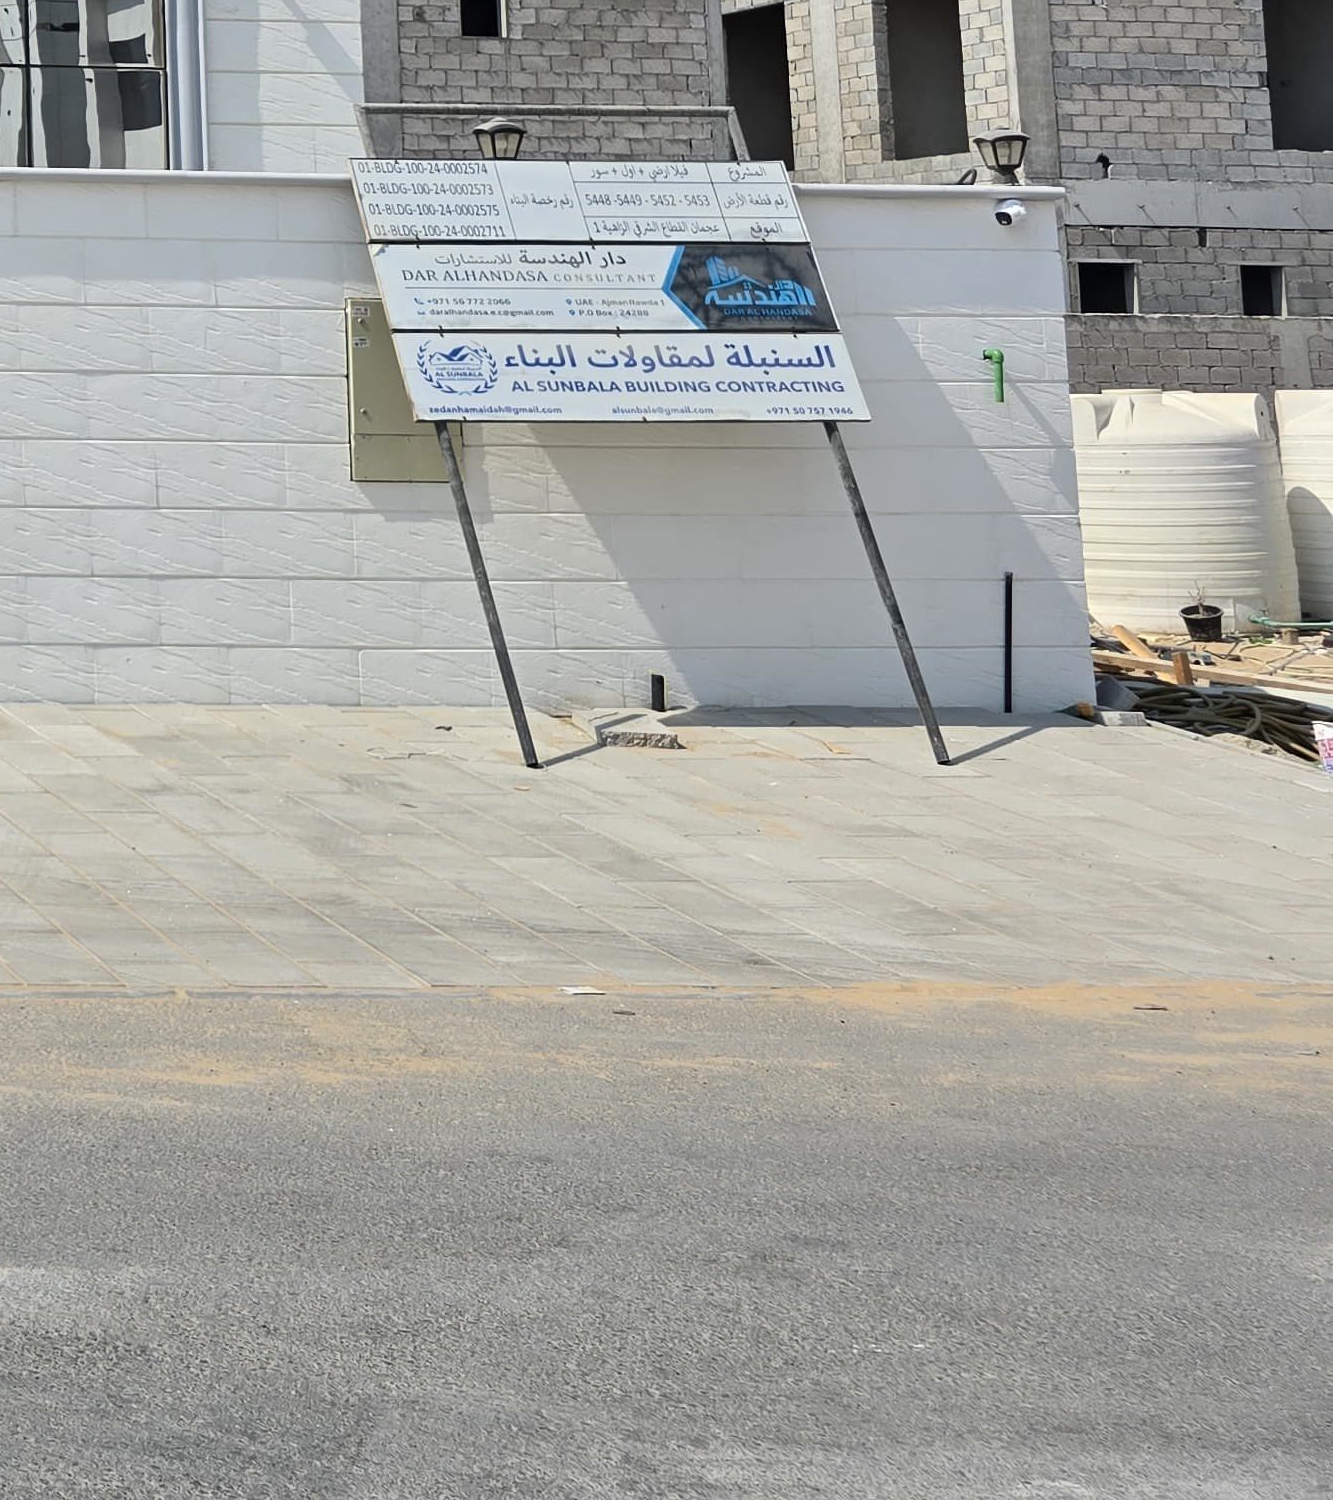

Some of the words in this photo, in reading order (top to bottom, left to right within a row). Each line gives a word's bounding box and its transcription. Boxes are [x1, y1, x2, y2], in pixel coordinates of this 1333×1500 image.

[357, 161, 488, 175] 01-BLDG-100-24-0002574
[727, 164, 767, 181] المشروع
[362, 182, 494, 195] 01-BLDG-100-24-0002573
[530, 192, 557, 208] رخصة
[559, 193, 574, 210] رقم
[584, 193, 612, 206] 5448
[650, 194, 677, 206] 5452
[684, 194, 710, 206] 5453
[747, 193, 772, 206] قطعة
[774, 193, 789, 210] رقم
[368, 203, 500, 216] 01-BLDG-100-24-0002575
[373, 223, 506, 237] 01-BLDG-100-24-0002711
[690, 220, 720, 235] عجمان
[749, 221, 783, 239] الموقع
[434, 253, 513, 267] للاستشارات
[518, 249, 592, 268] الهندسة
[599, 251, 627, 268] دار
[401, 269, 438, 281] DAR
[443, 270, 549, 282] ALHANDASA
[553, 273, 657, 283] CONSULTANT
[504, 344, 578, 376] البناء
[587, 344, 716, 374] لمقاولات
[724, 344, 836, 376] السنبلة
[511, 380, 534, 393] AL
[537, 380, 622, 393] SUNBALA
[625, 380, 712, 393] BUILDING
[715, 380, 846, 394] CONTRACTING
[792, 406, 806, 415] 50
[828, 406, 854, 415] 1946
